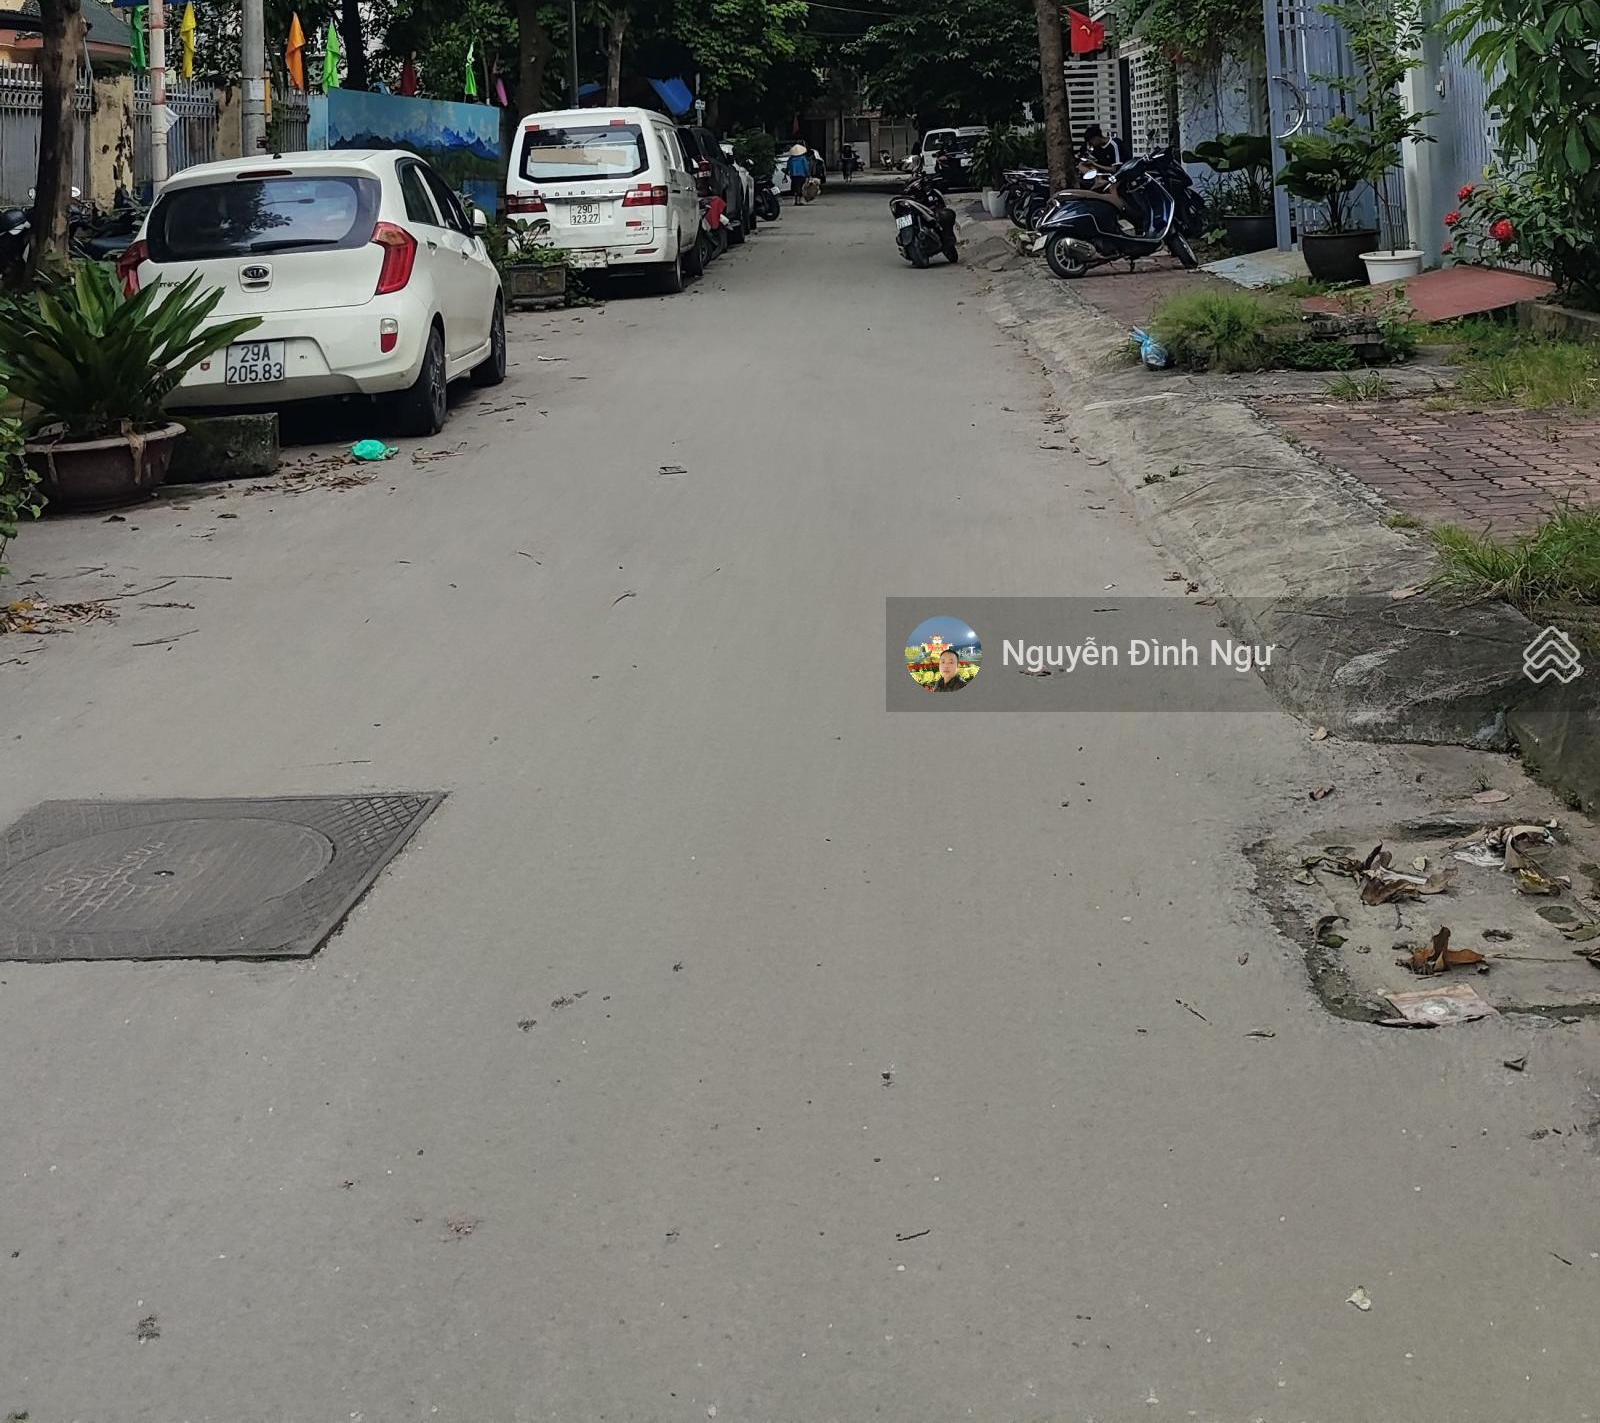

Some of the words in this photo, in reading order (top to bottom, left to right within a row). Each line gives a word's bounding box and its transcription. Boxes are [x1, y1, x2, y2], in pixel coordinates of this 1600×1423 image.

[246, 268, 265, 278] KIA
[240, 344, 271, 363] 29A
[228, 362, 283, 384] 205.83
